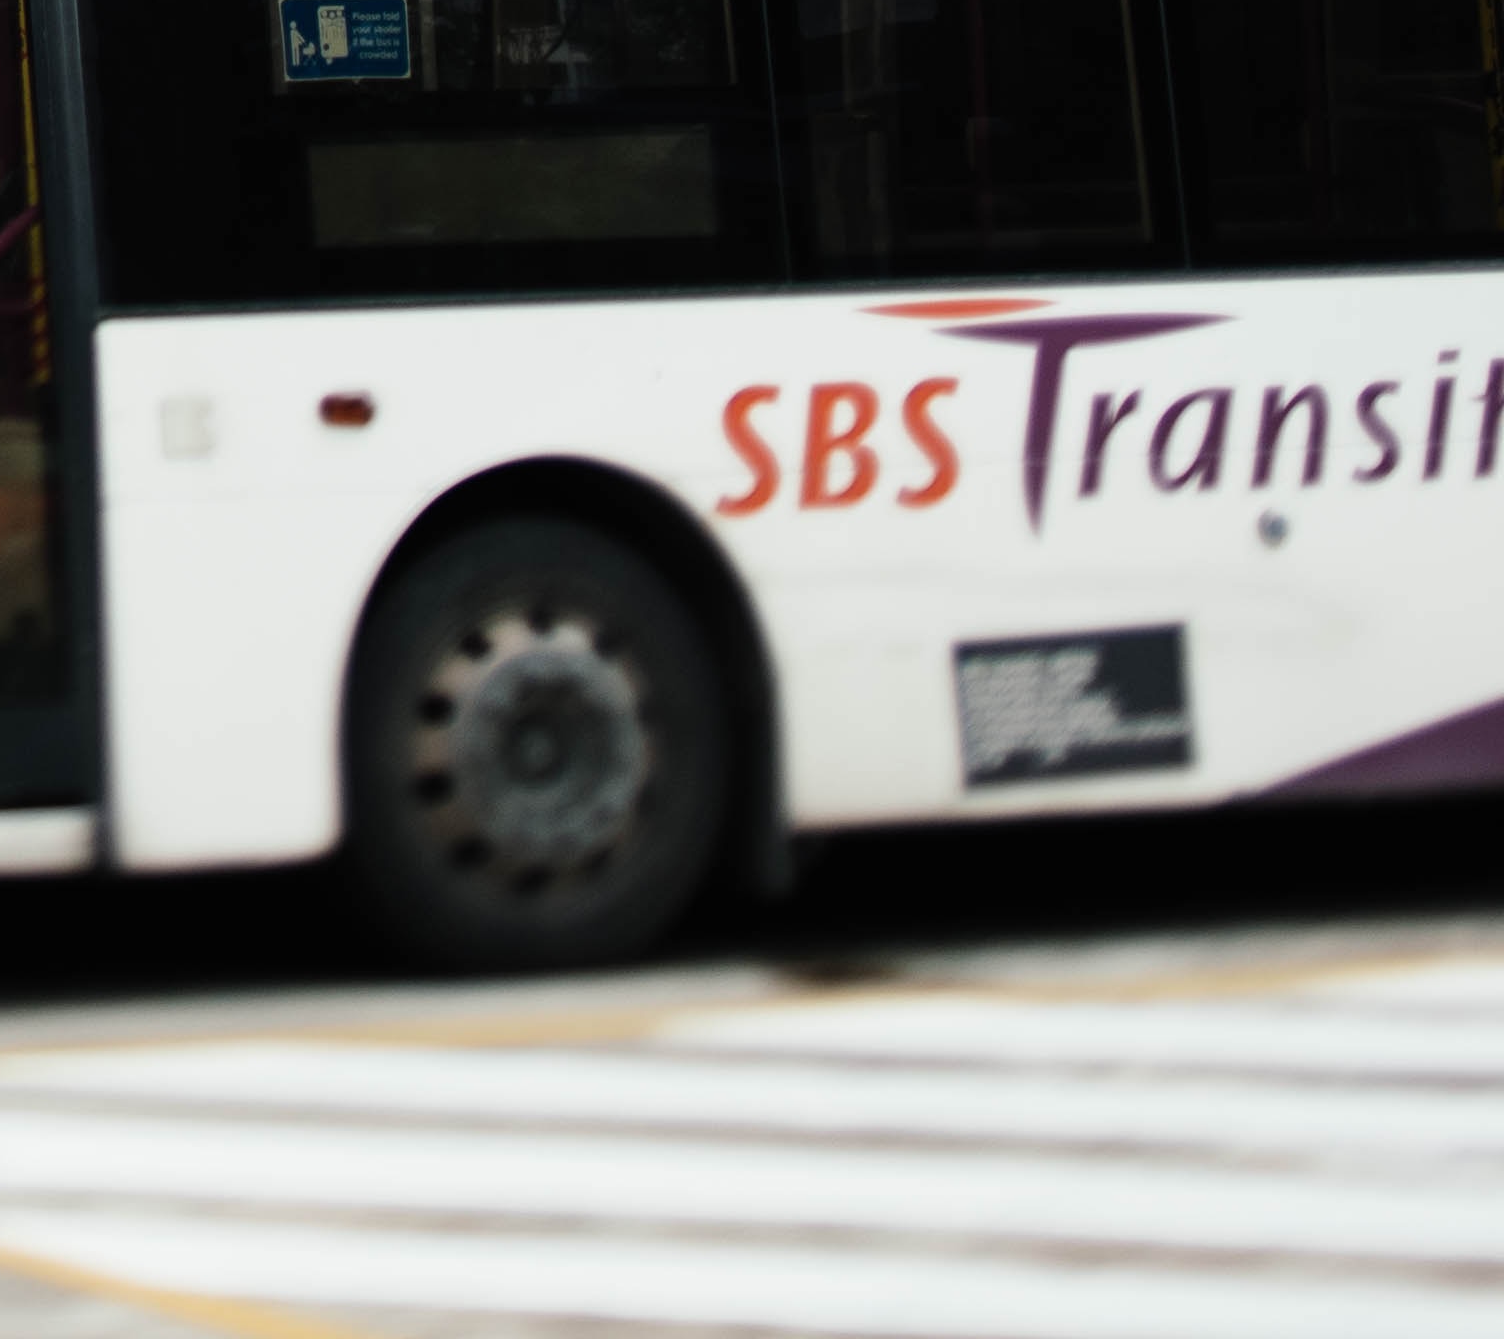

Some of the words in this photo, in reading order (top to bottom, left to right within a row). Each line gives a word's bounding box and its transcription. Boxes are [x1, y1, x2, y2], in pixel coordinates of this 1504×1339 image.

[352, 12, 381, 21] Please
[383, 11, 400, 21] fold
[352, 26, 371, 35] your
[359, 37, 374, 46] the
[376, 37, 391, 46] bus
[359, 50, 399, 59] crowded
[715, 375, 960, 517] SBS
[928, 311, 1504, 537] Transit
